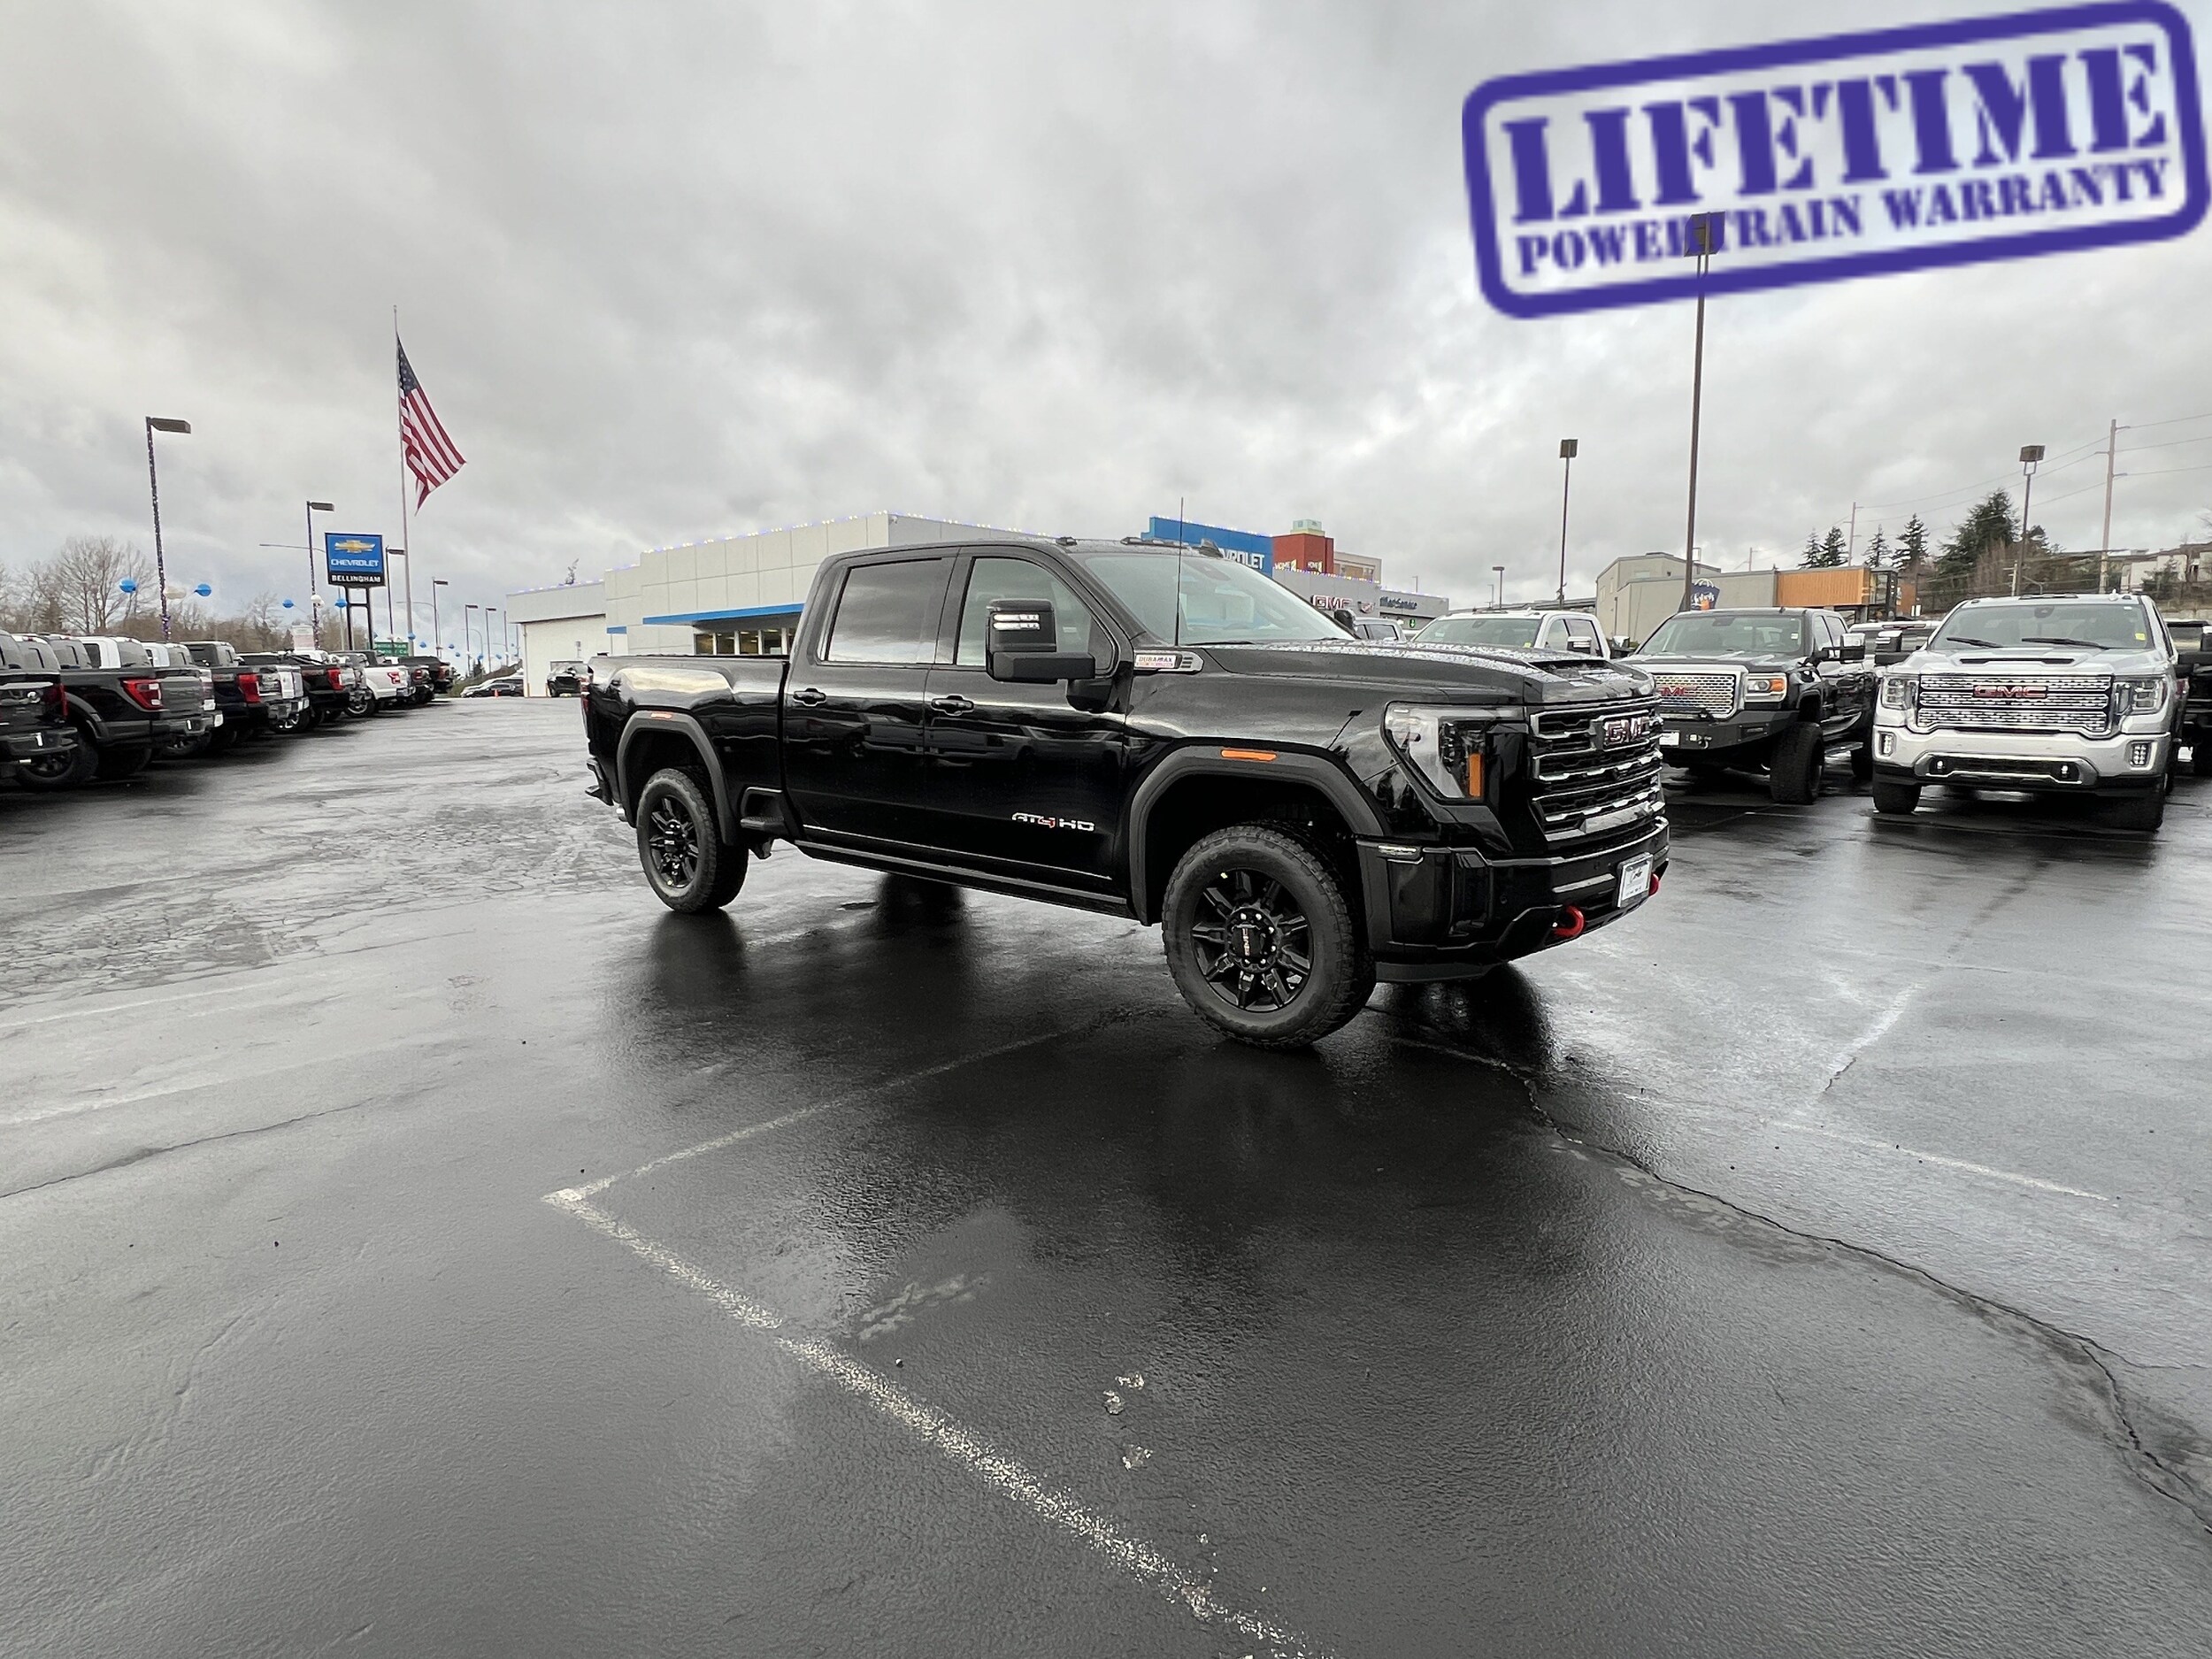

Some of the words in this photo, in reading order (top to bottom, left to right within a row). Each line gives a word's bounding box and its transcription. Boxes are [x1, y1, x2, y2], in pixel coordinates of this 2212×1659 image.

[1974, 686, 2047, 698] GMC
[1605, 717, 1650, 742] GMC
[1011, 812, 1056, 828] AT4
[1059, 818, 1095, 831] HD
